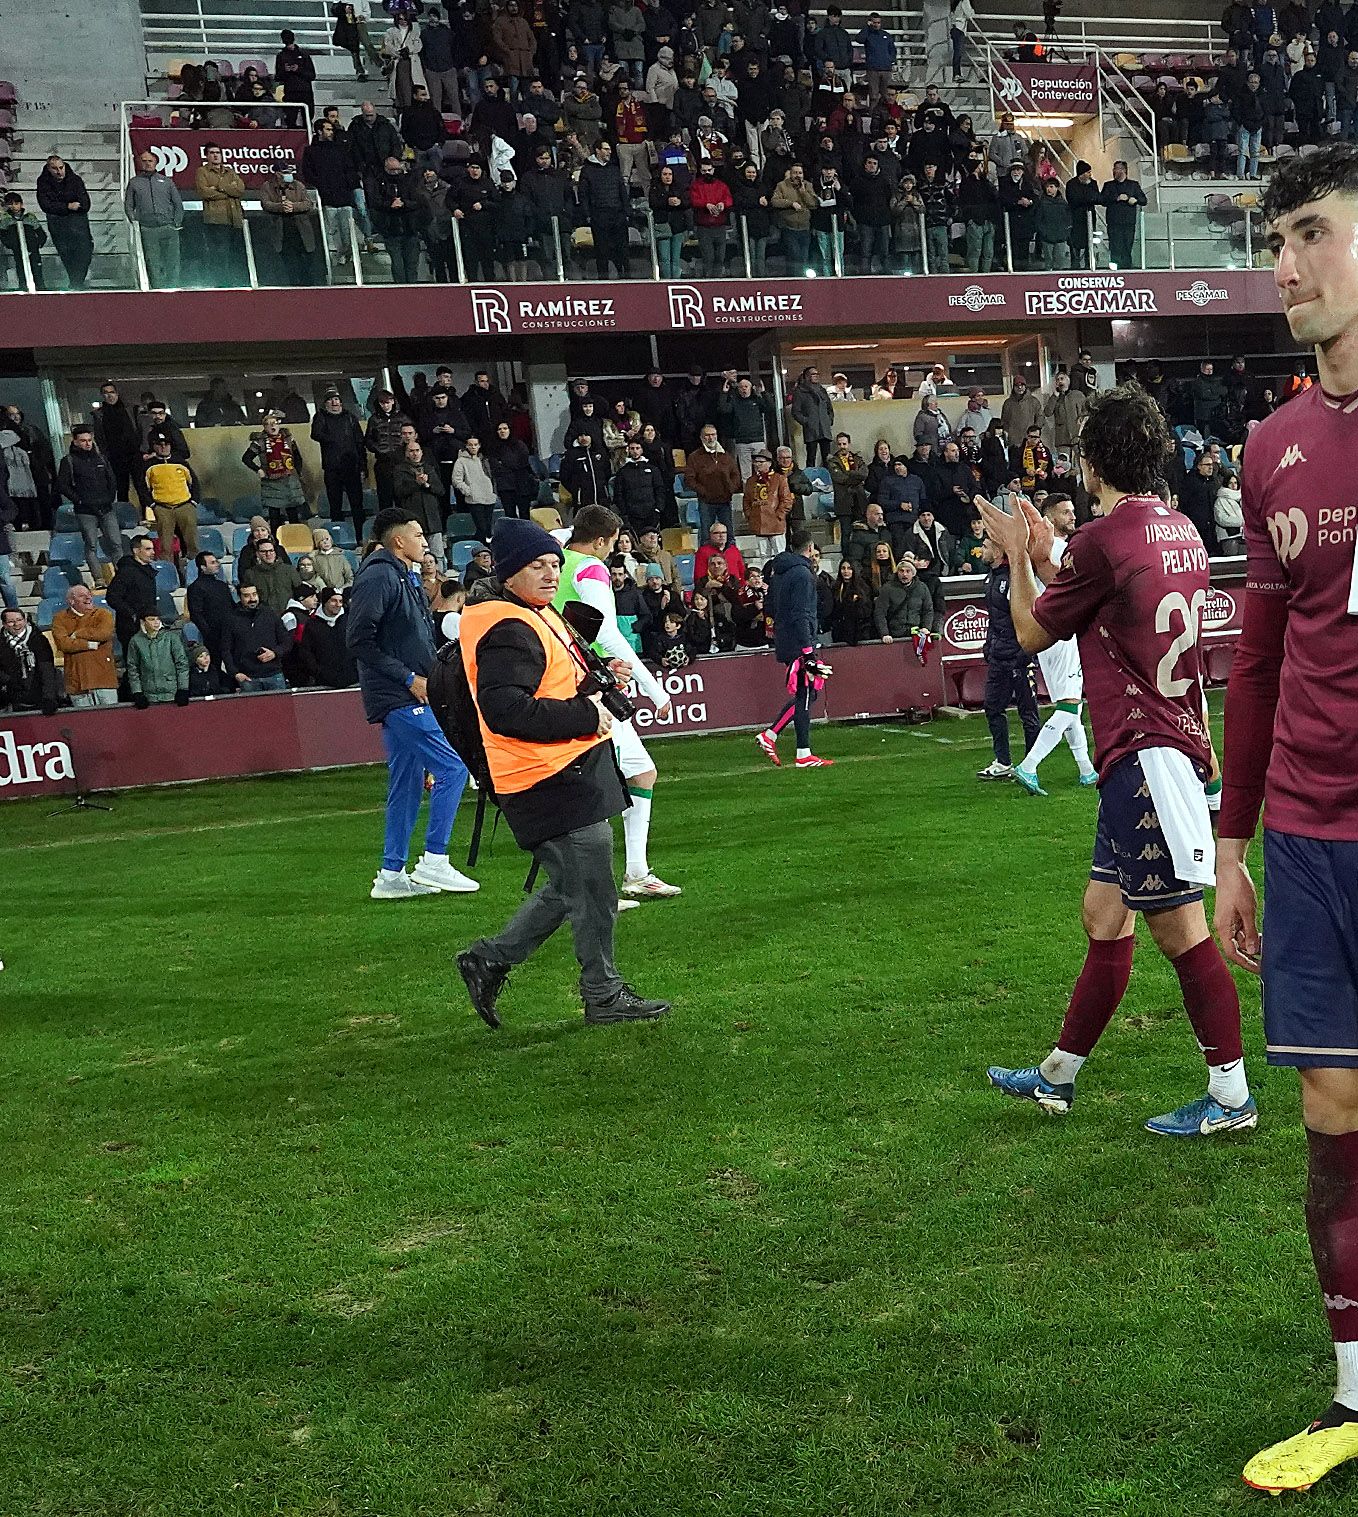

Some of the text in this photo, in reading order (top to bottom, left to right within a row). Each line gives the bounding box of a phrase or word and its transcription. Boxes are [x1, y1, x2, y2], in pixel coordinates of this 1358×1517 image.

[1031, 78, 1092, 90] Deputación
[1031, 89, 1093, 100] Pontevedra
[1058, 276, 1125, 289] CONSERVAS
[948, 294, 1006, 307] PESCAMAR
[1176, 289, 1228, 301] PESCAMAR
[519, 295, 615, 318] RAMÍREZ
[712, 291, 803, 312] RAMÍREZ
[1024, 289, 1158, 315] PESCAMAR
[521, 318, 616, 329] CONSTRUCCIONES
[715, 313, 804, 324] CONSTRUCCIONES
[1161, 548, 1207, 575] PELAYO
[1203, 608, 1228, 619] alicia
